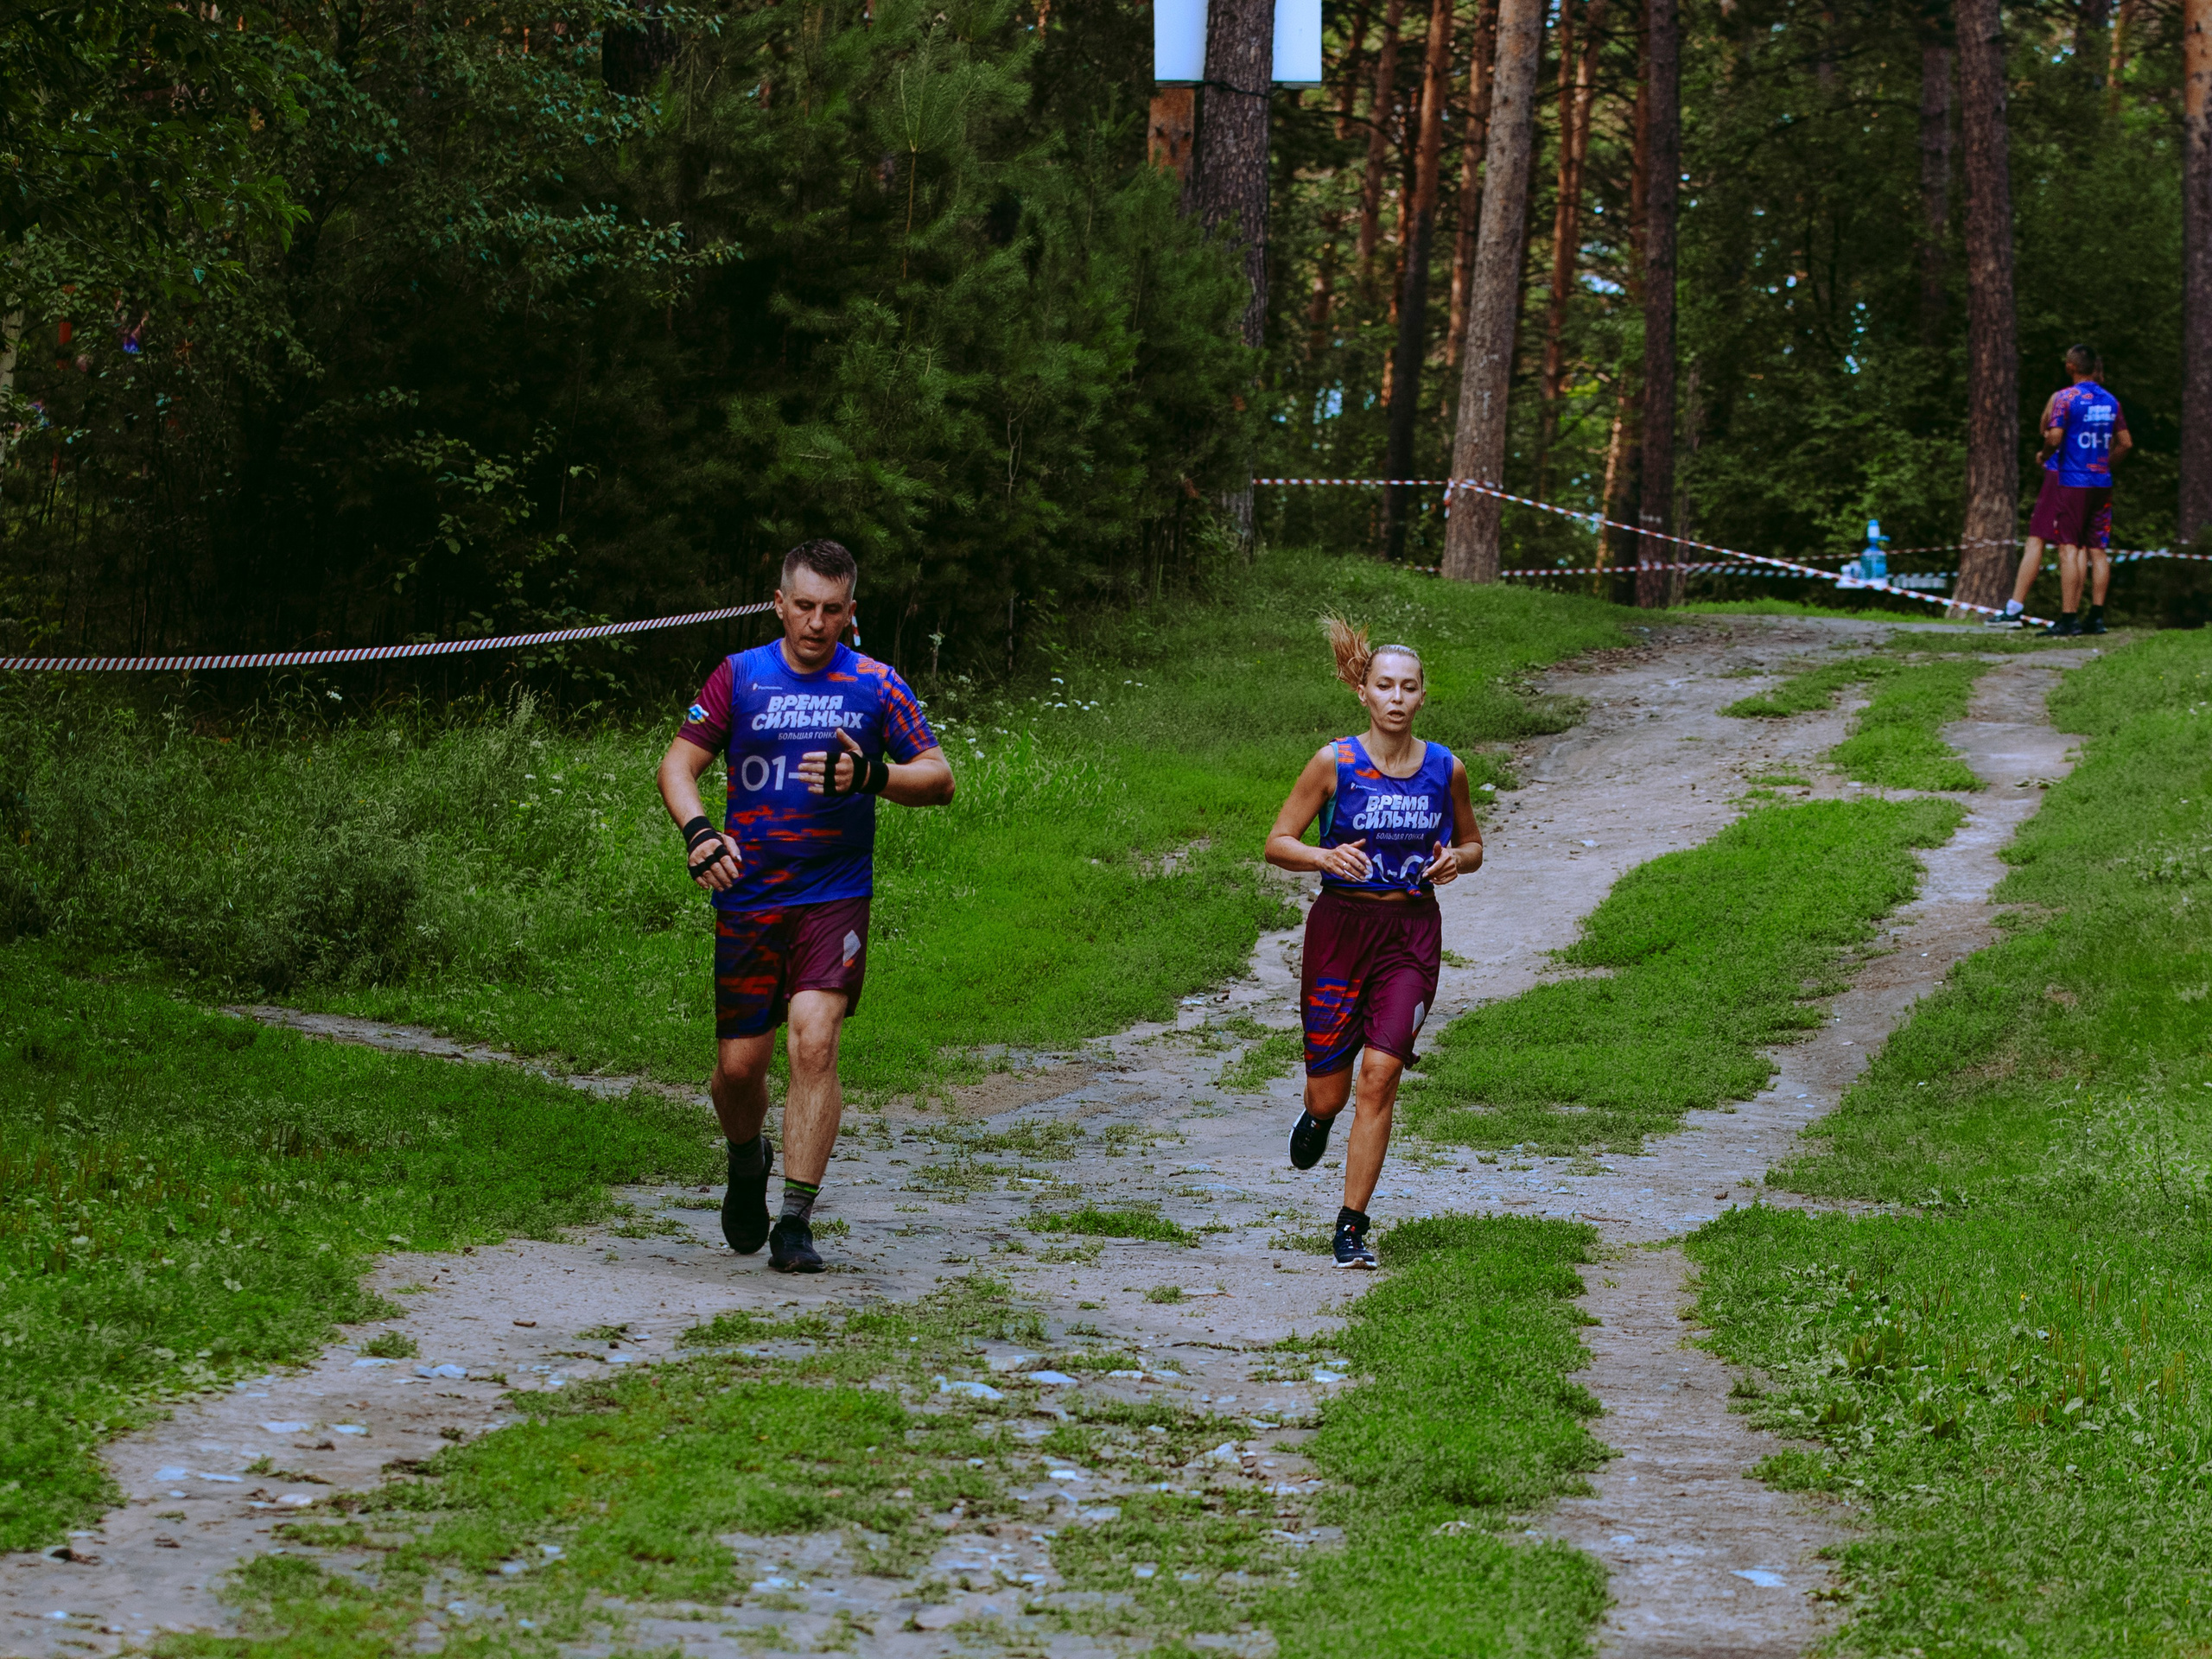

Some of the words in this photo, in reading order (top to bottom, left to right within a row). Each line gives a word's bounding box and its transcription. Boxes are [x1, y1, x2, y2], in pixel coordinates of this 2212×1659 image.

[767, 694, 843, 713] ВРЕМЯ
[751, 710, 864, 731] СИЛЬНЫХ
[778, 732, 813, 741] БОЛЬШАЯ
[814, 731, 837, 740] ГОНКА
[741, 755, 823, 791] 01-
[1365, 794, 1429, 812] ВРЕМЯ
[1352, 810, 1442, 830] СИЛЬНЫХ
[1376, 832, 1405, 841] БОЛЬШАЯ
